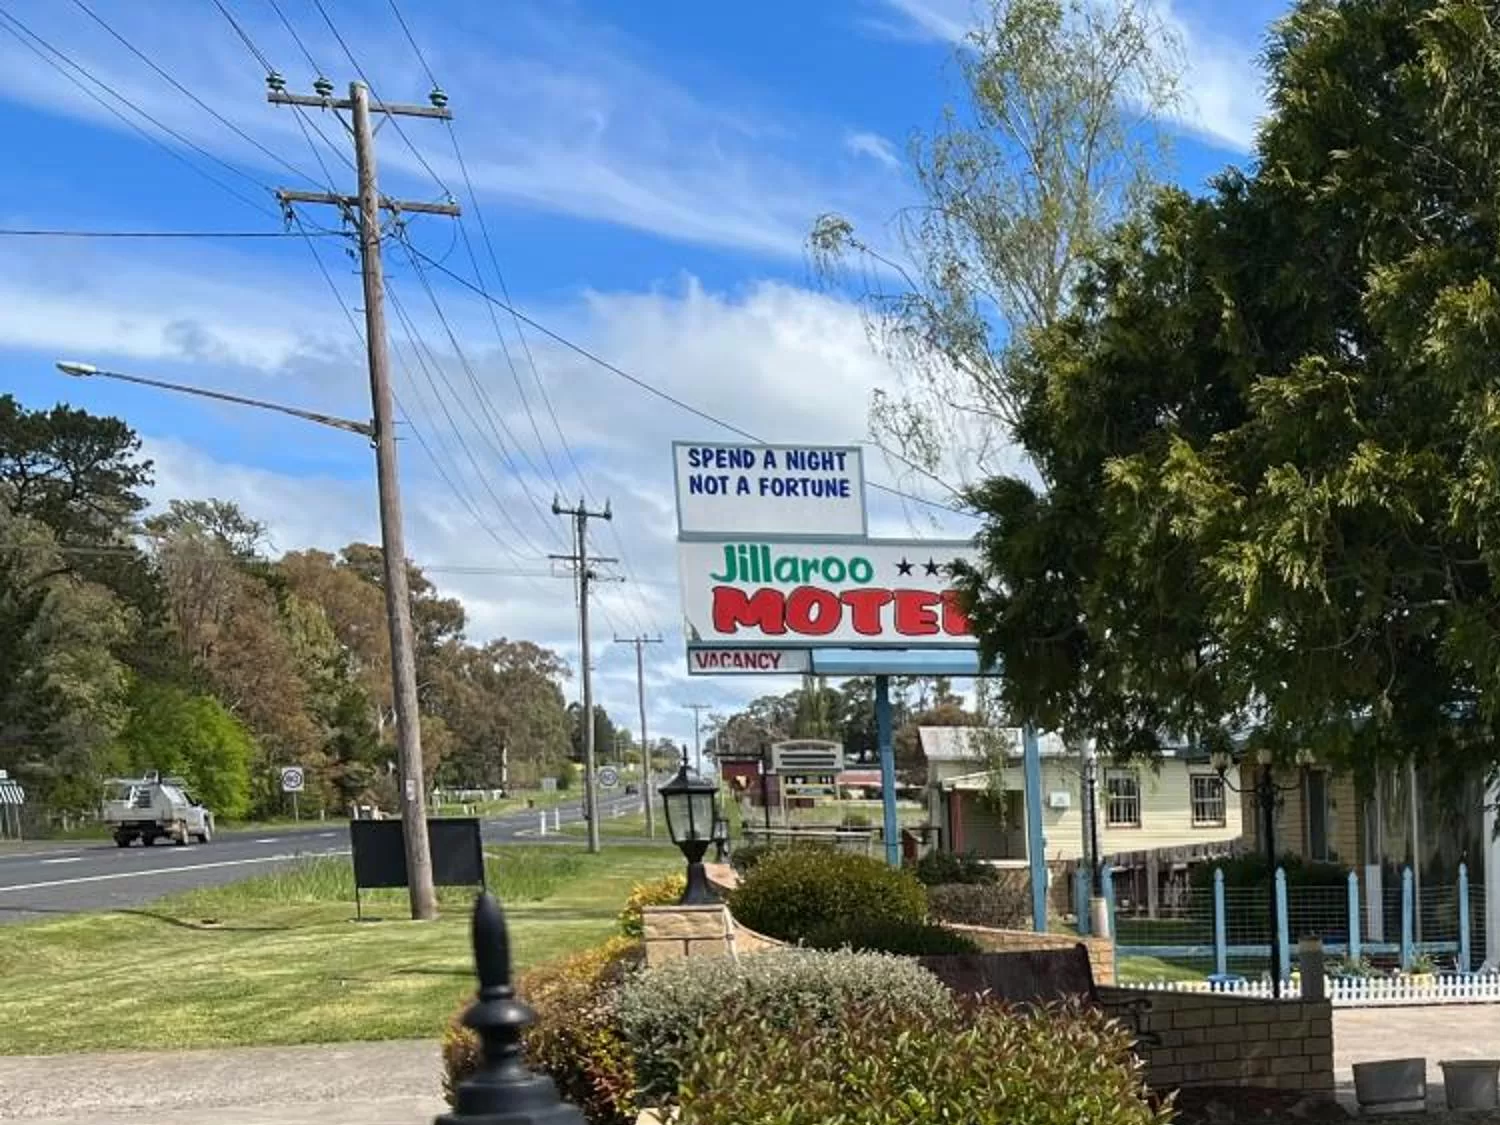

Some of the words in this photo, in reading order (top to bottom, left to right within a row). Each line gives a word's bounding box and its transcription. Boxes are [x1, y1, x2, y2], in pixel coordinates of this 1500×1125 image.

[688, 448, 756, 469] SPEND
[763, 450, 777, 470] A
[785, 450, 847, 471] NIGHT
[689, 474, 729, 495] NOT
[737, 476, 751, 495] A
[758, 478, 851, 498] FORTUNE
[710, 545, 874, 583] Jillaroo
[695, 651, 782, 670] VACANCY
